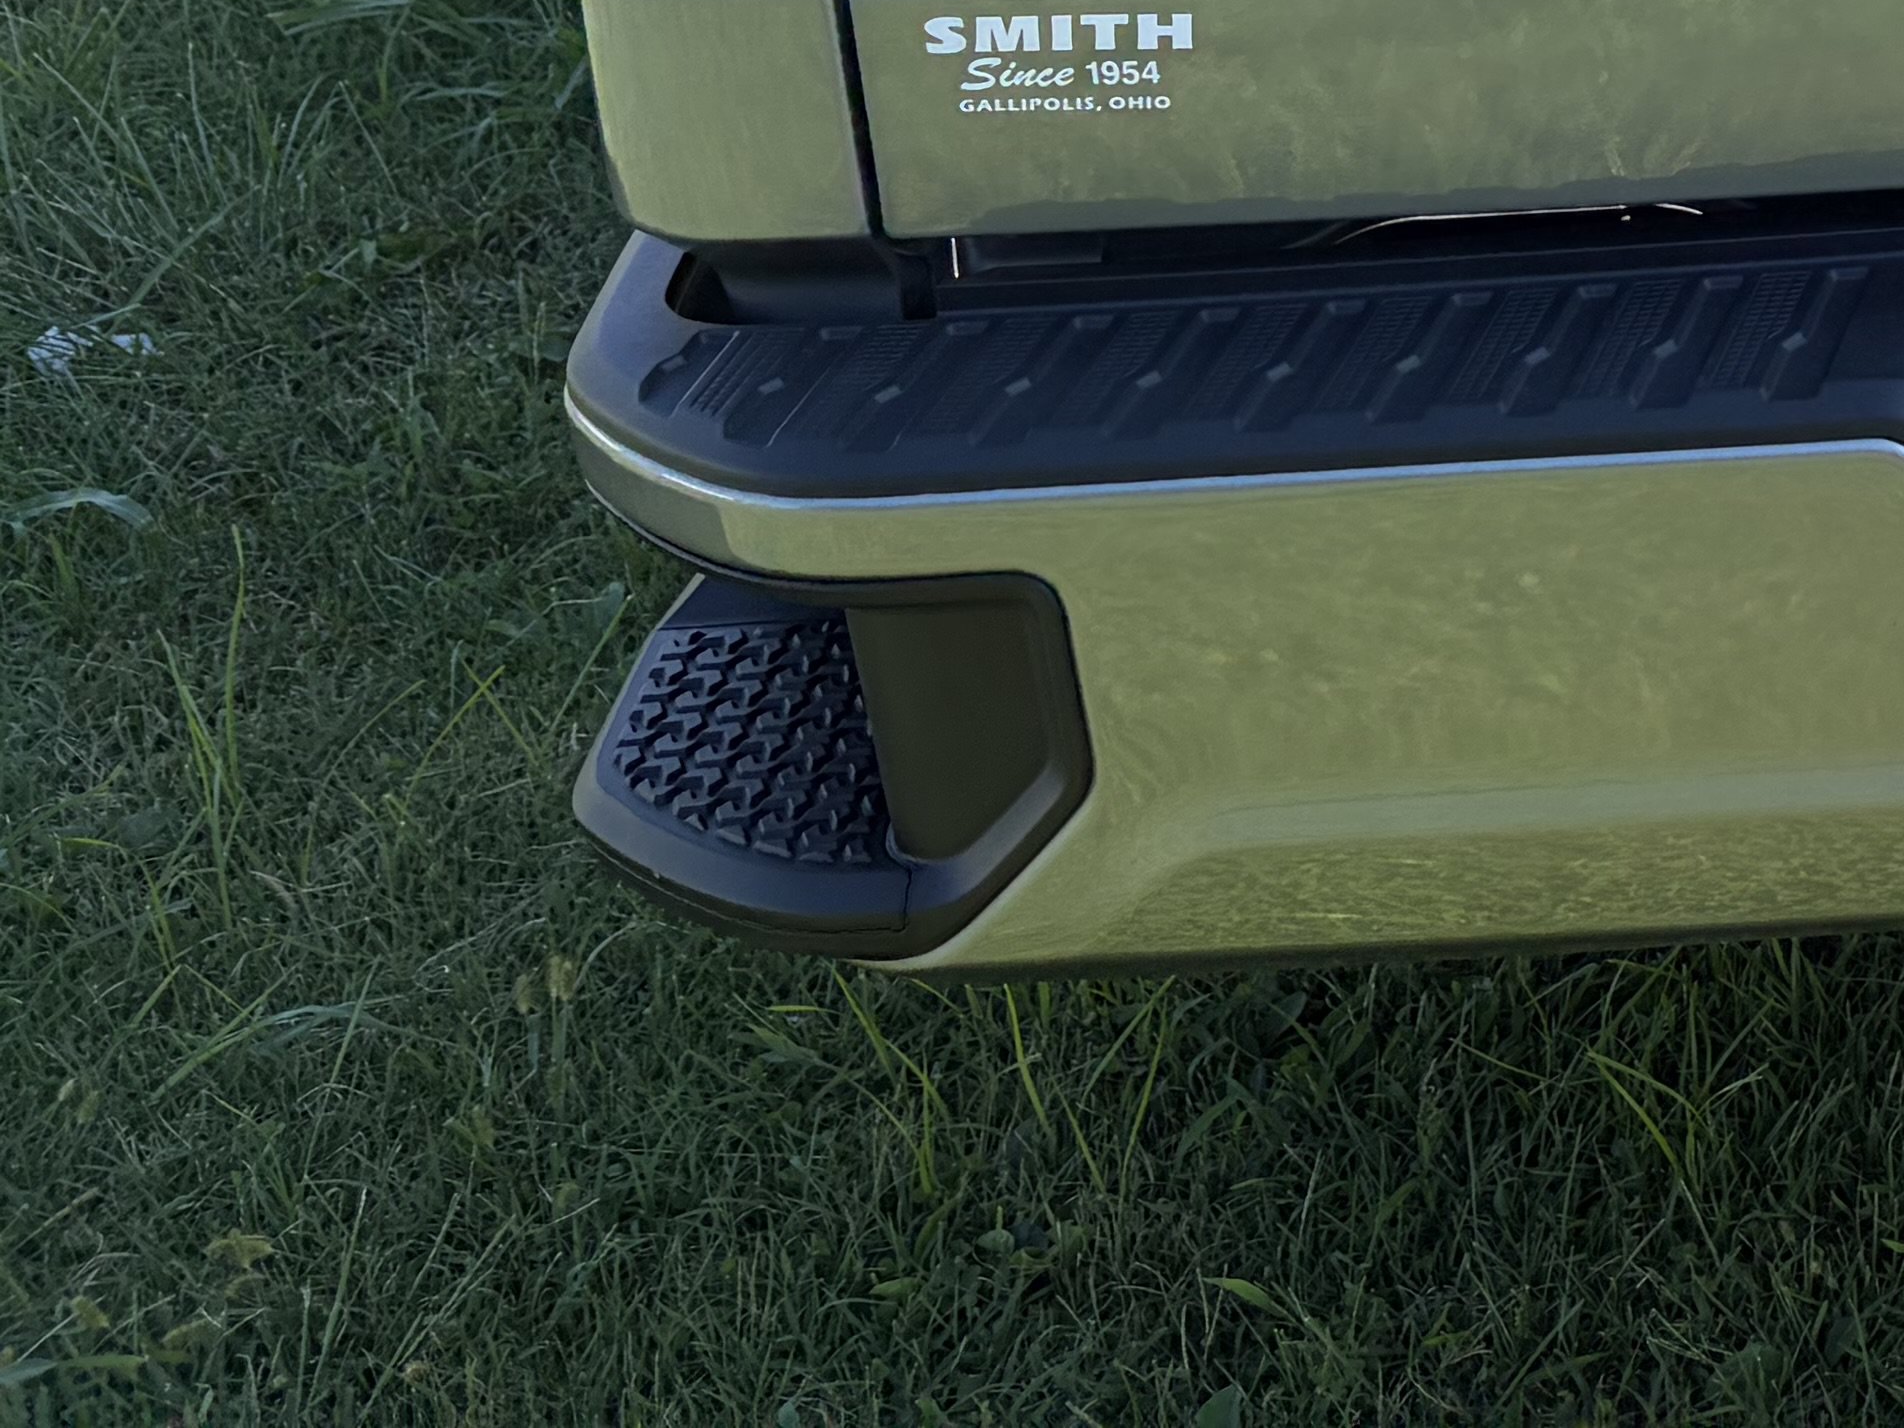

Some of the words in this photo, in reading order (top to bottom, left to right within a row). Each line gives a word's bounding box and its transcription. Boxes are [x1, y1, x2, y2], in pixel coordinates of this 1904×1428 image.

[923, 12, 1194, 55] SMITH
[960, 57, 1076, 91] Since
[1085, 60, 1162, 87] 1954
[959, 96, 1103, 113] GALLIPOLIS,
[1108, 95, 1172, 111] OHIO
